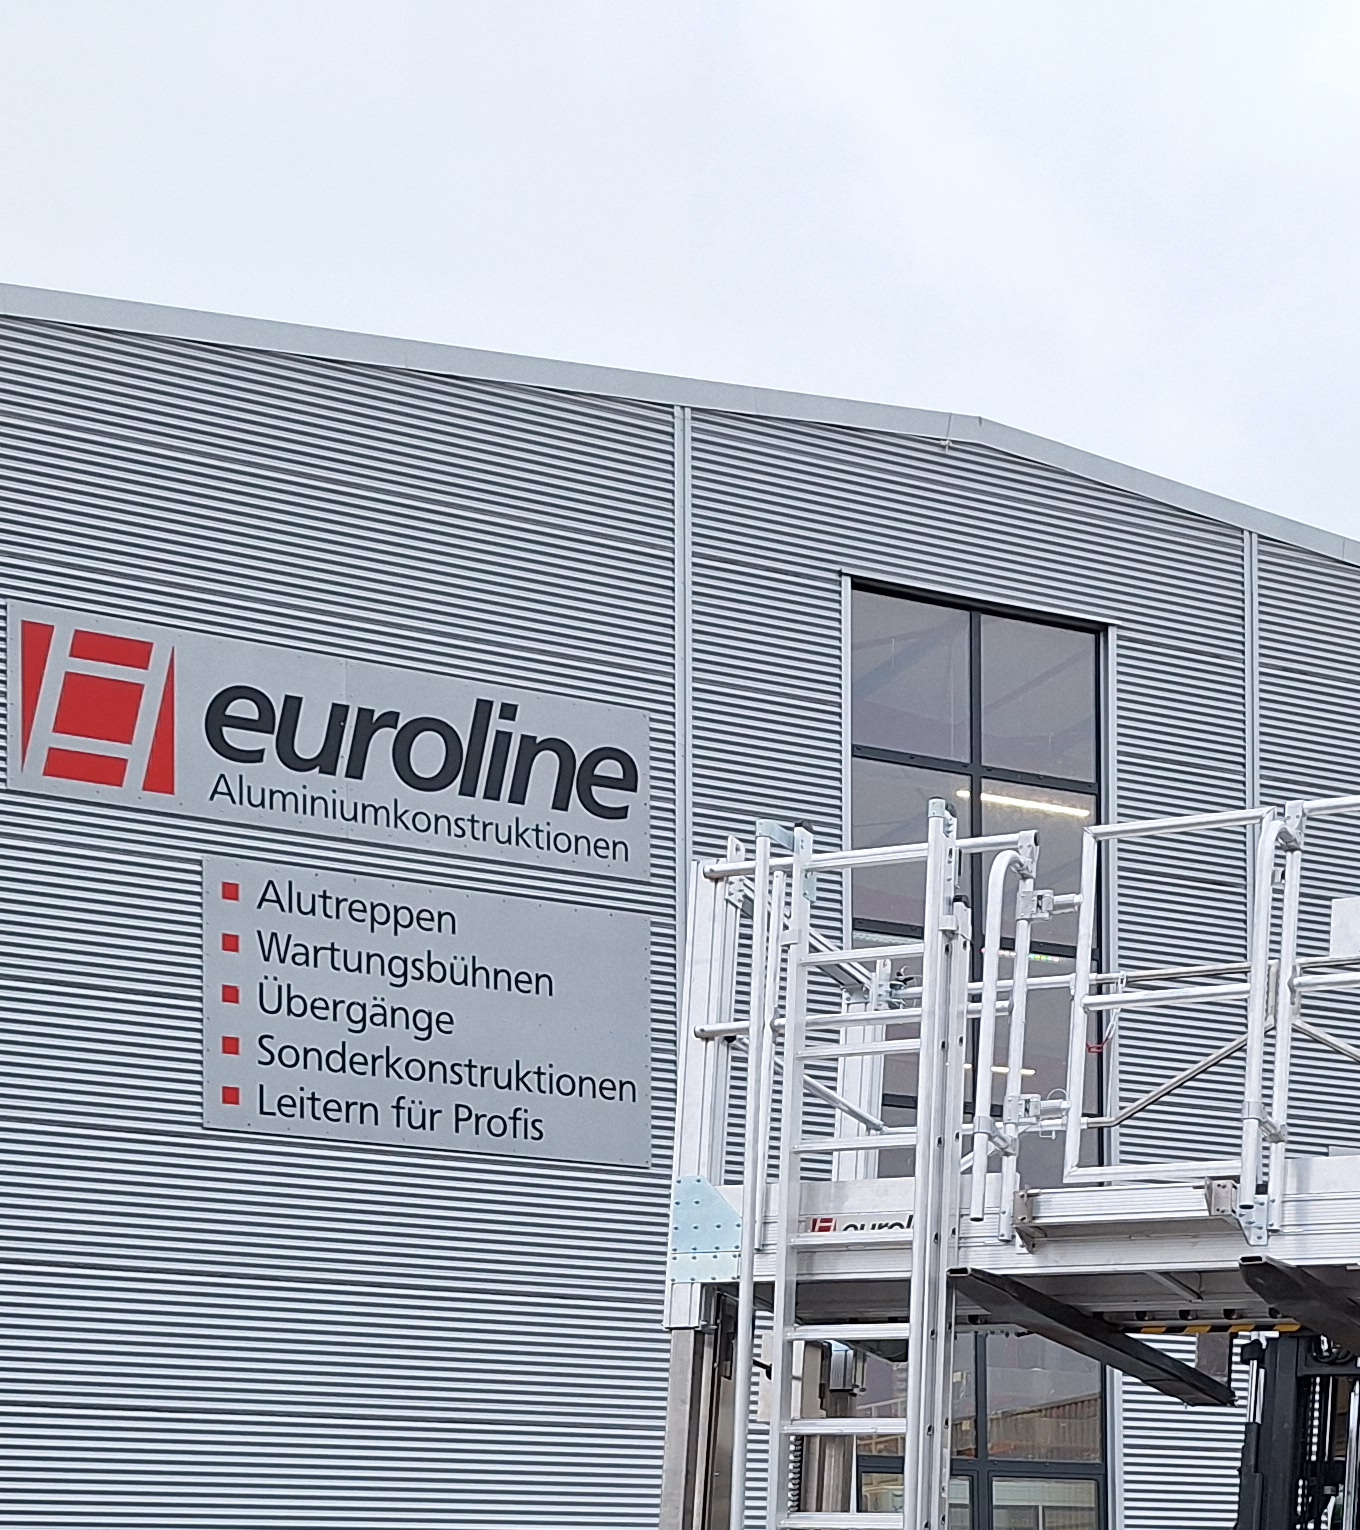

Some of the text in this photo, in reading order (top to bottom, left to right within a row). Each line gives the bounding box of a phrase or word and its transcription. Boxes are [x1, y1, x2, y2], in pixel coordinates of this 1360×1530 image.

[205, 686, 638, 820] euroline
[209, 773, 629, 862] Aluminiumkonstruktionen
[257, 879, 456, 936] Alutreppen
[257, 930, 553, 996] Wartungsbühnen
[258, 975, 455, 1041] Übergänge
[257, 1035, 636, 1102] Sonderkonstruktionen
[259, 1084, 544, 1140] Leitern für Profis
